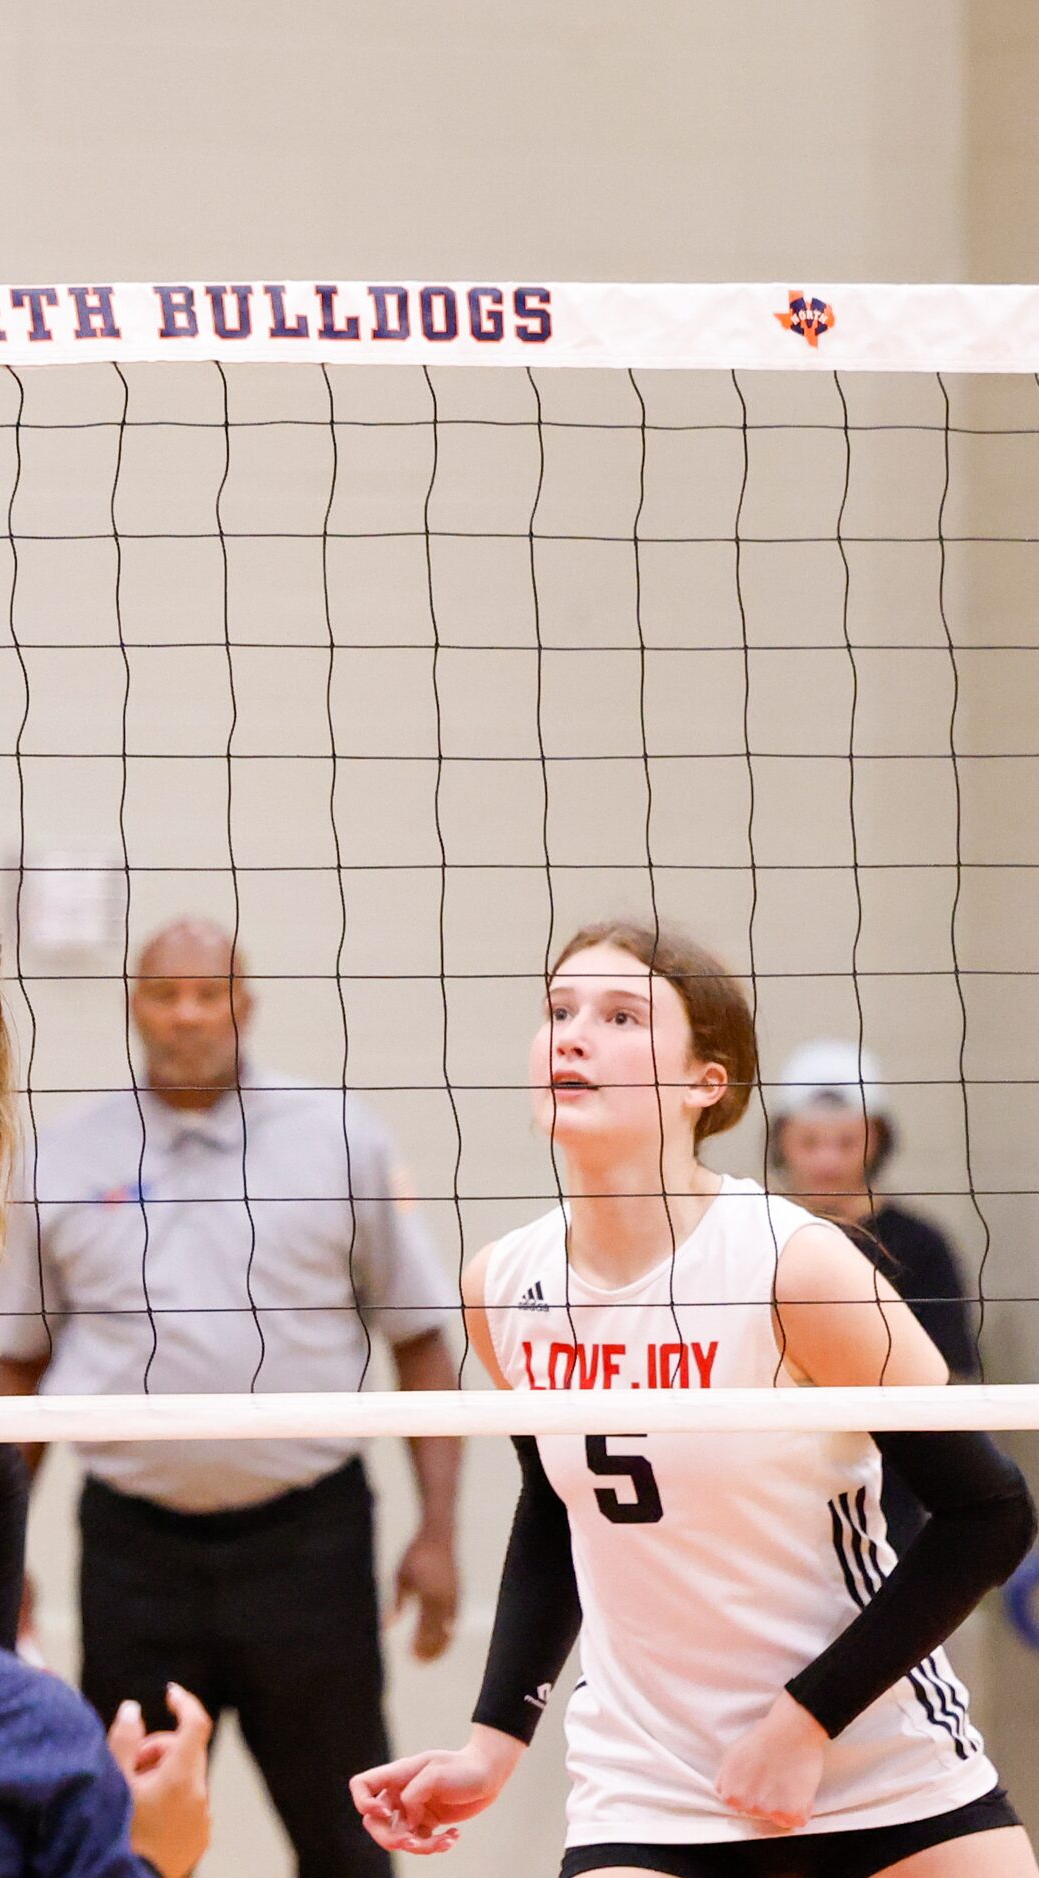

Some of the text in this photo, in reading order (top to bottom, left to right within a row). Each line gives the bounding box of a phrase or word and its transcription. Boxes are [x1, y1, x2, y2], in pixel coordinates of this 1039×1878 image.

[152, 284, 553, 343] BULLDOGS
[790, 309, 829, 326] NORTH
[585, 1433, 664, 1524] 5
